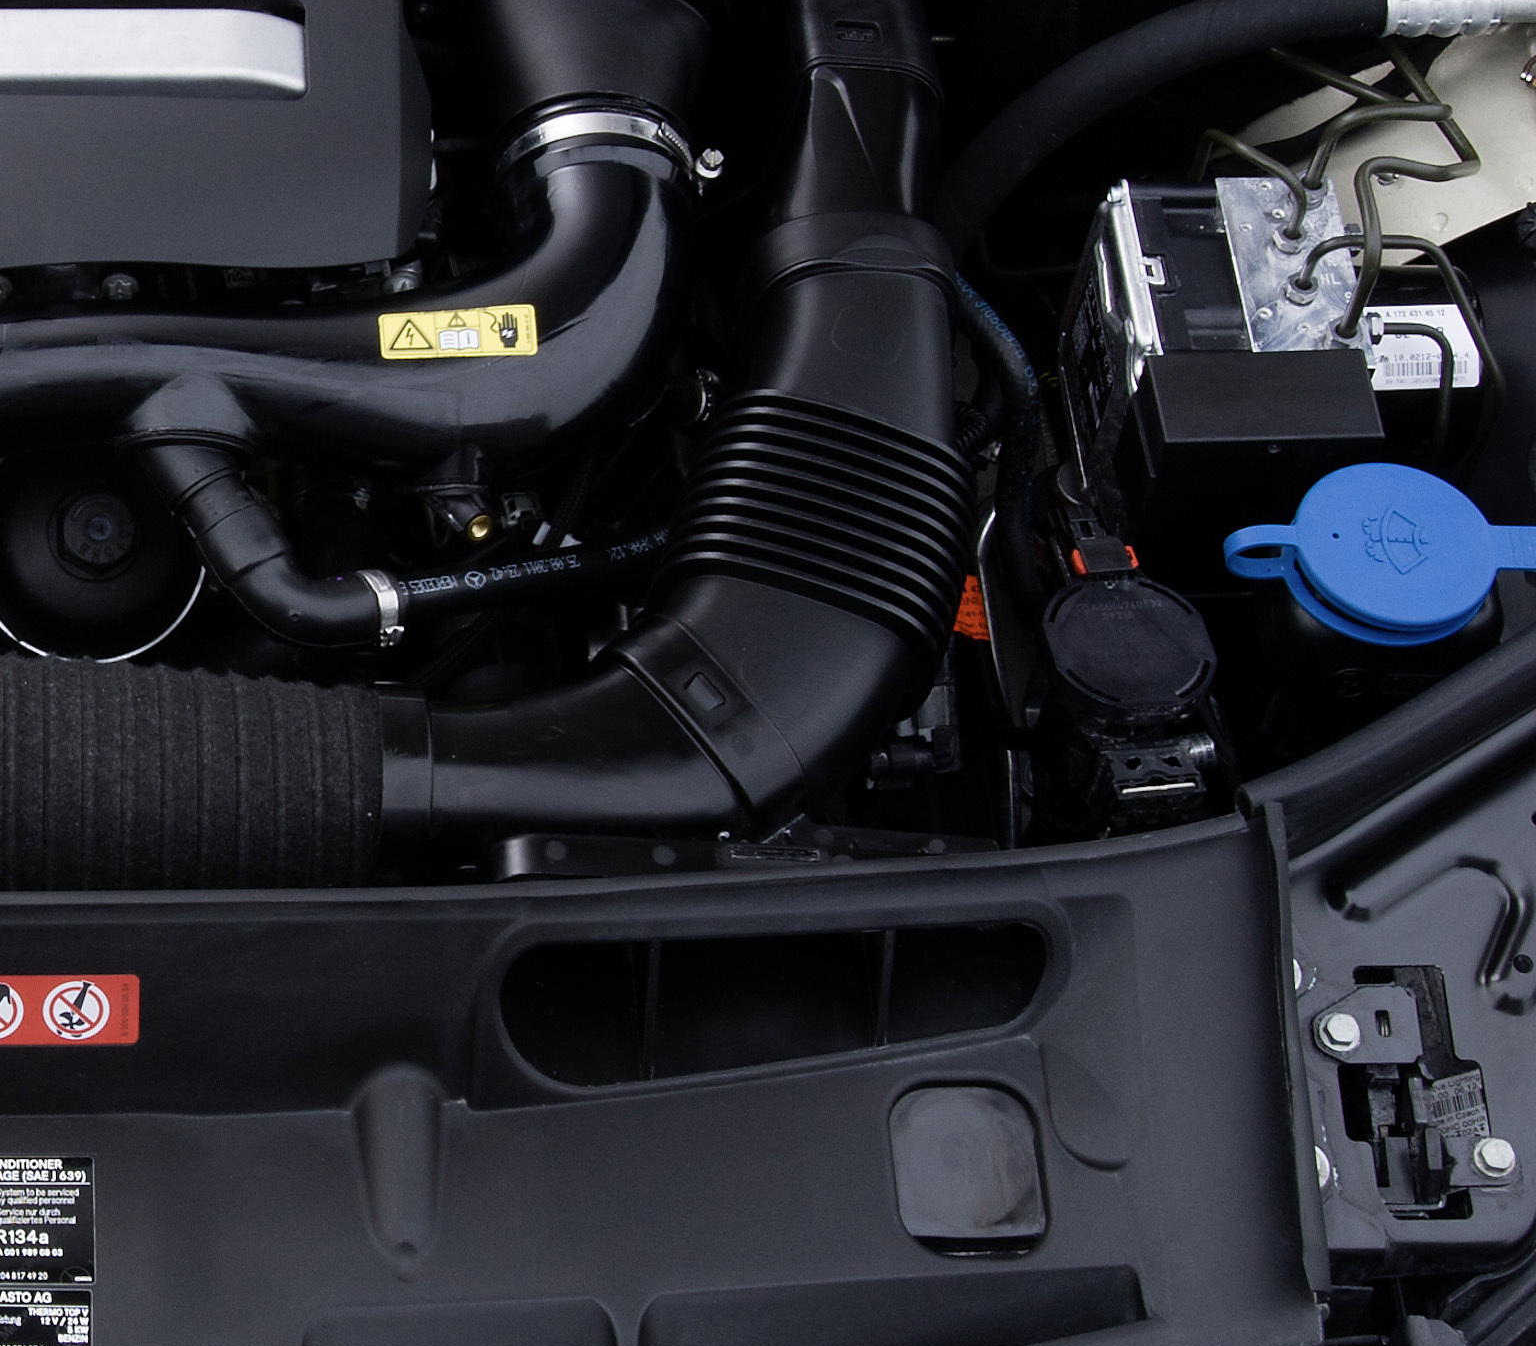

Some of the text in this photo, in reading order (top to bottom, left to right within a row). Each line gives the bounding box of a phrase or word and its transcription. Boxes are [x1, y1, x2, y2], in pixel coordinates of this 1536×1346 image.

[412, 574, 458, 595] MERCEDES
[22, 1170, 49, 1183] (SAE
[51, 1170, 57, 1182] J
[59, 1170, 87, 1183] 639)
[35, 1188, 46, 1197] be
[47, 1188, 80, 1197] serviced
[7, 1196, 38, 1206] qualified
[39, 1197, 76, 1206] personnel
[25, 1208, 37, 1216] nur
[38, 1207, 61, 1216] durch
[43, 1216, 77, 1225] Personal
[34, 1291, 53, 1304] AG
[28, 1307, 63, 1317] THERMO
[64, 1307, 81, 1317] TOP
[40, 1317, 51, 1325] 12
